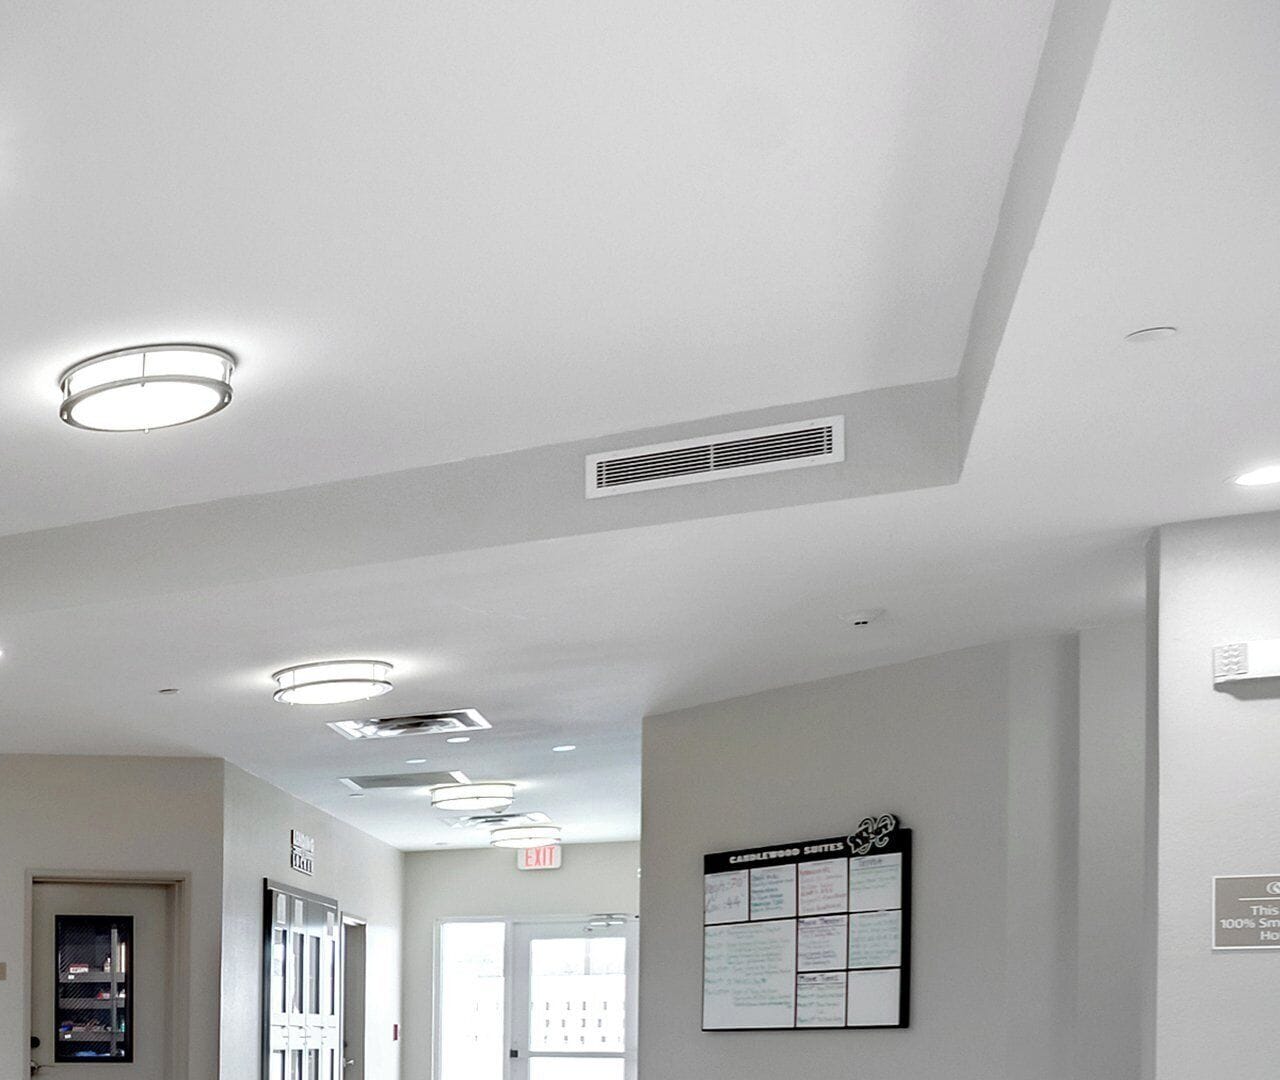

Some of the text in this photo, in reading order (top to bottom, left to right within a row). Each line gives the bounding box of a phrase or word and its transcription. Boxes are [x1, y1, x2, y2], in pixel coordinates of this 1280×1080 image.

[525, 846, 555, 867] EXIT
[729, 842, 844, 864] CANDLEWOOD SUITES
[1249, 904, 1279, 916] This
[1219, 918, 1256, 929] 100%
